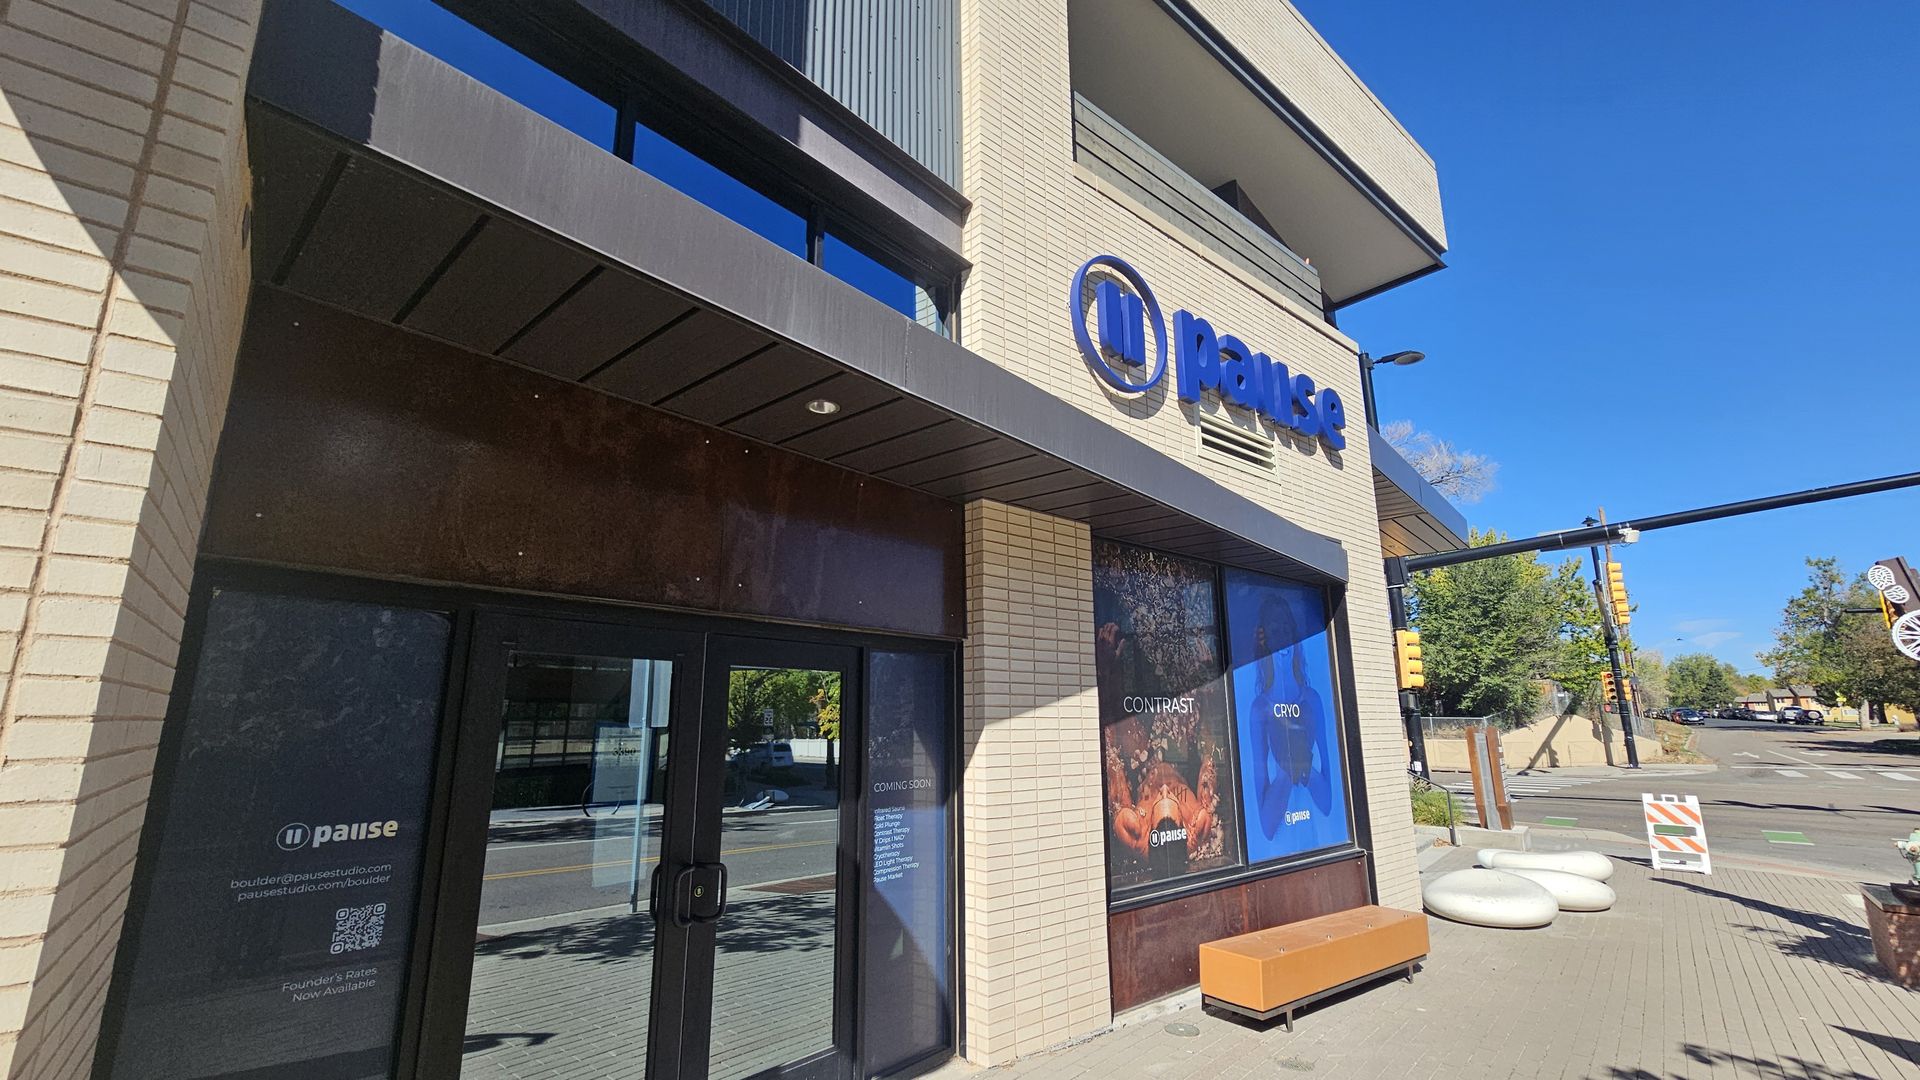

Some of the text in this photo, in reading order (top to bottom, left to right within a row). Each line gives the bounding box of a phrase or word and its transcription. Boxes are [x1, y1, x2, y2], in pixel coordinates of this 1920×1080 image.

[1173, 309, 1346, 450] pause
[1123, 696, 1194, 713] CONTRAST
[1273, 703, 1300, 718] CRYO
[873, 779, 931, 793] COMING SOON
[1291, 810, 1310, 824] pause
[312, 820, 398, 848] pause
[1160, 828, 1187, 845] pause
[230, 863, 391, 889] boulder@pausestudio.com
[887, 872, 903, 880] Market
[237, 874, 391, 902] pausestudio.com/boulder
[346, 967, 377, 979] Rates
[292, 978, 376, 1002] Now Available
